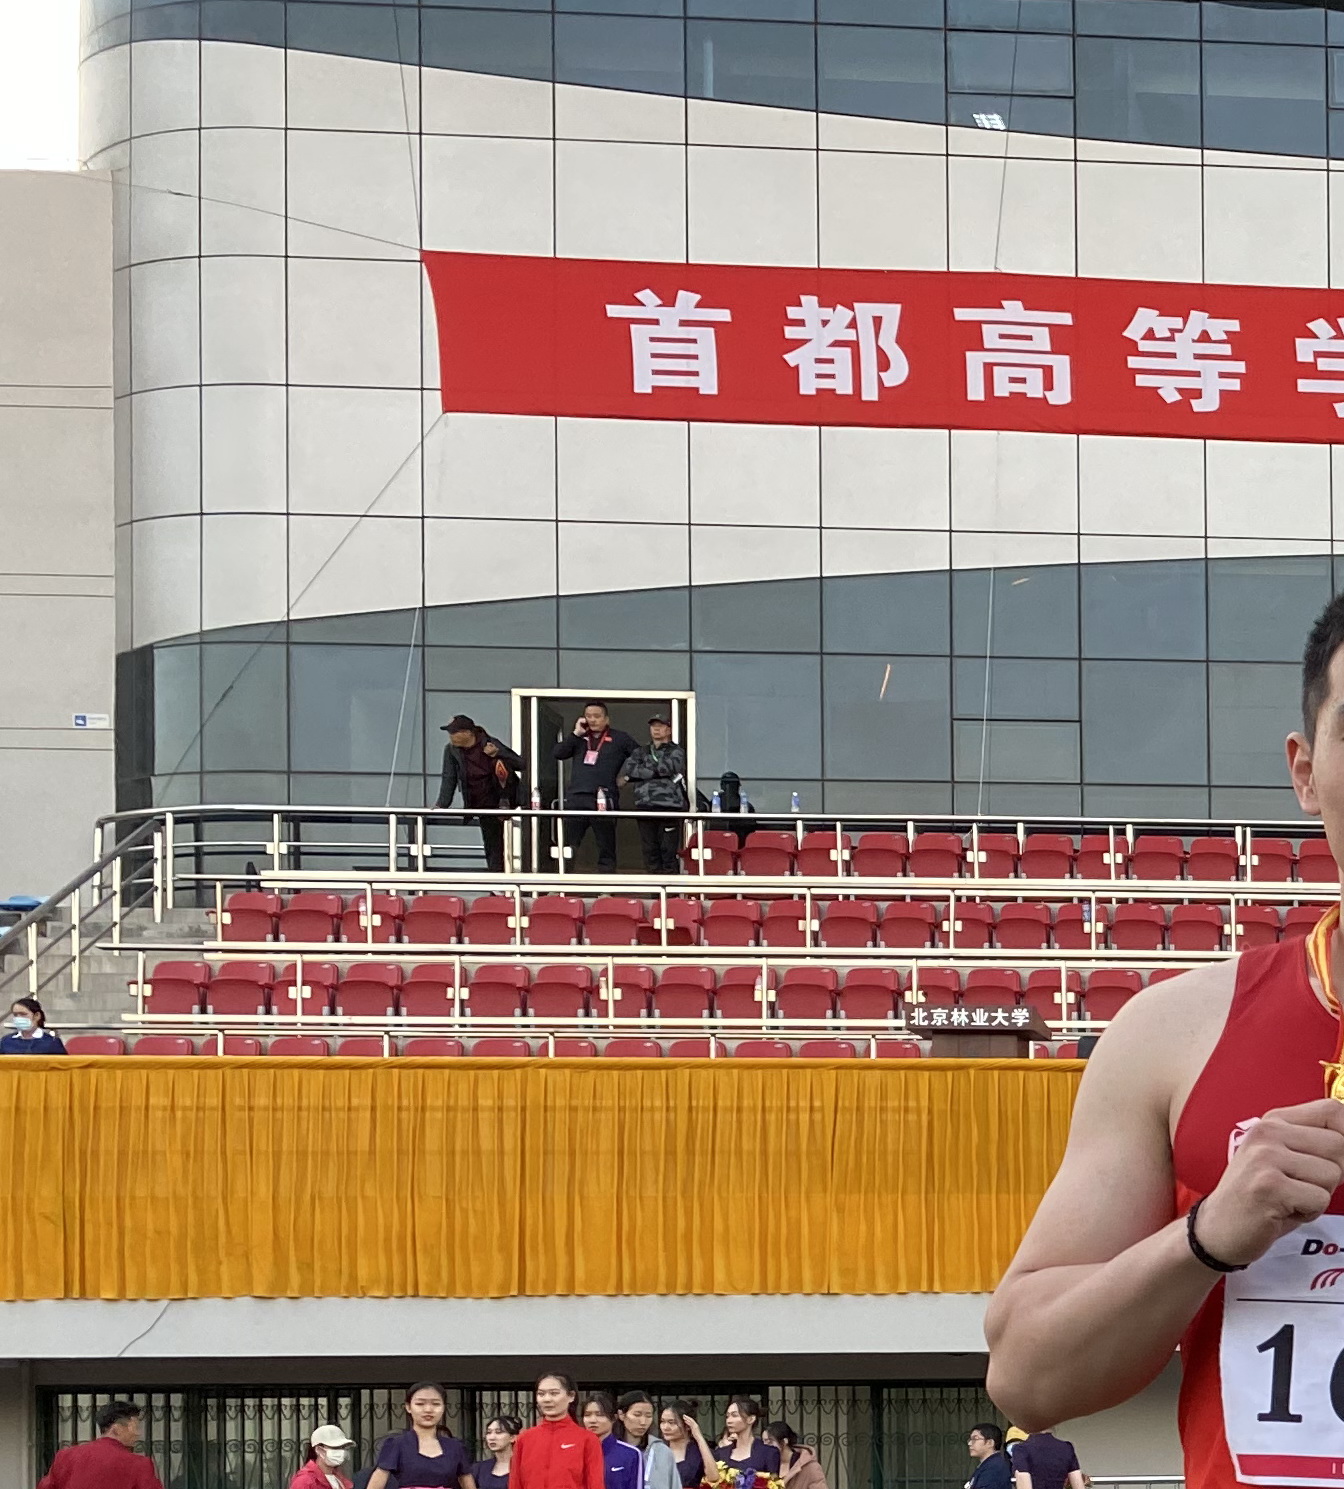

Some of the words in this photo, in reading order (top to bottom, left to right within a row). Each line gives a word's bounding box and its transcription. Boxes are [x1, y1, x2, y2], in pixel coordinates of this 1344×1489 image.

[910, 1008, 1030, 1027] 北京林业大学
